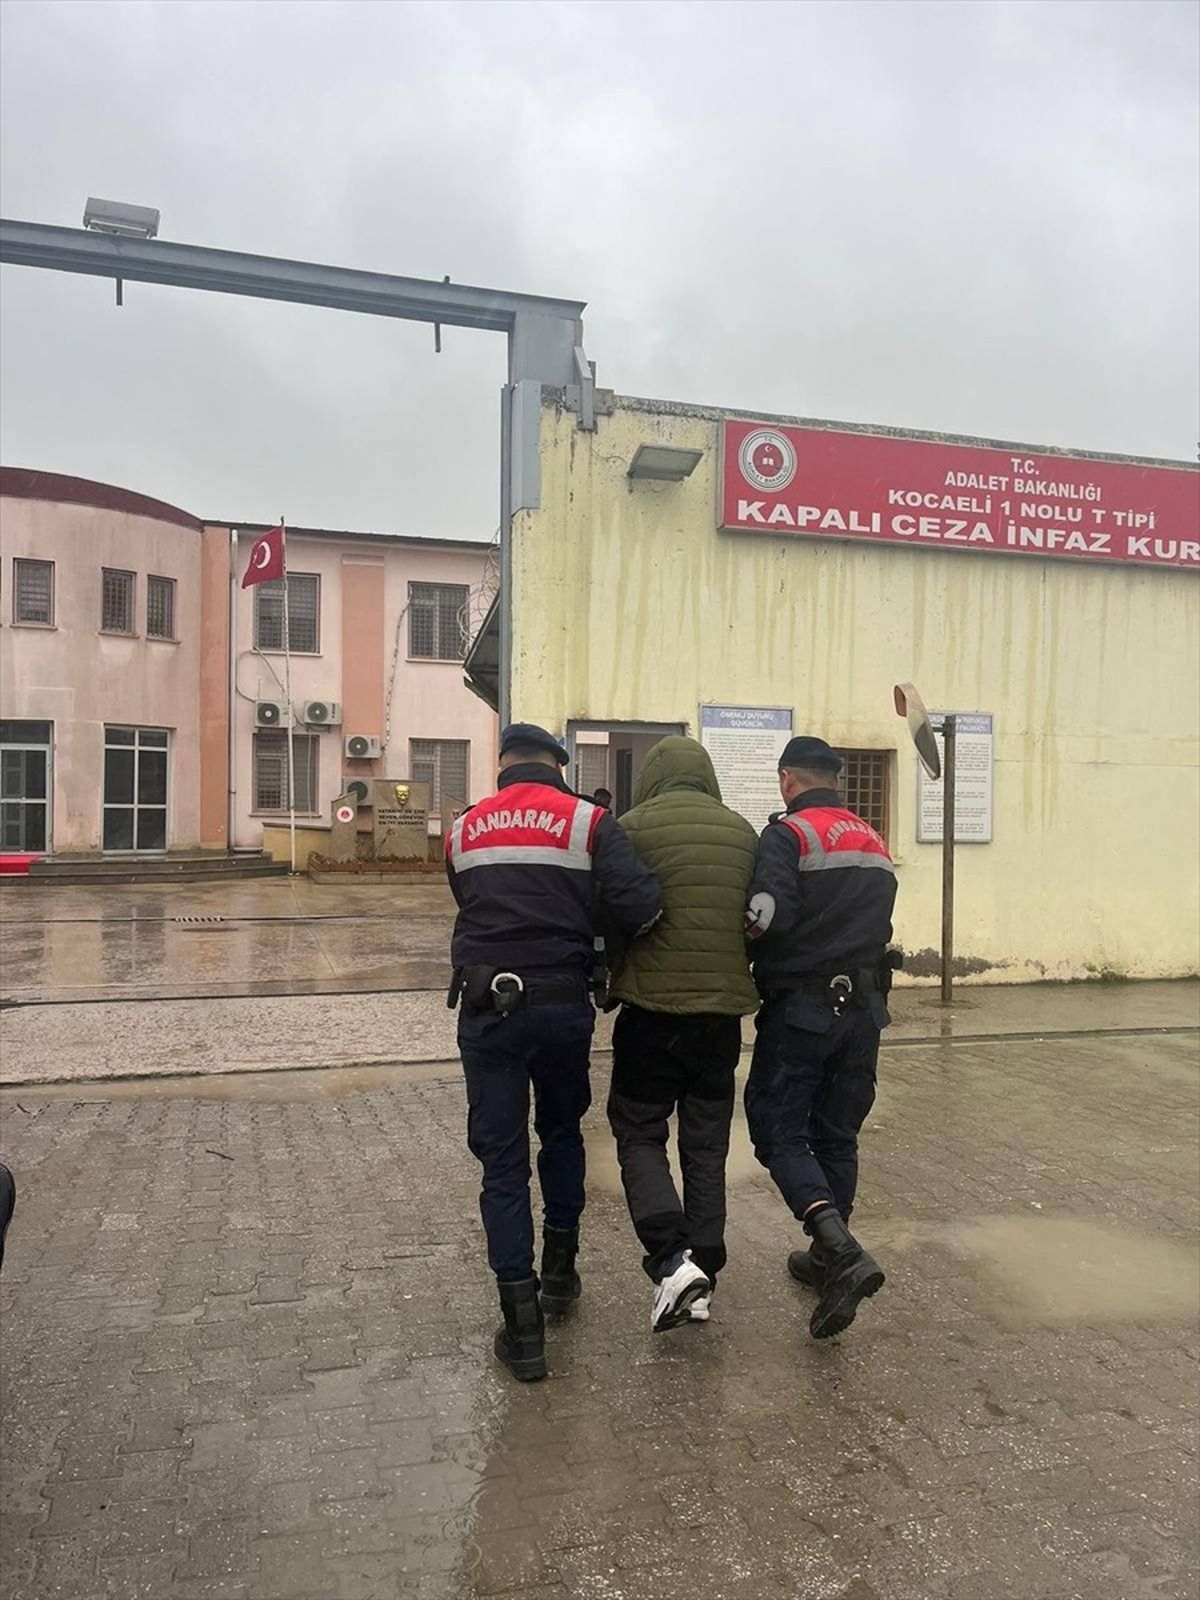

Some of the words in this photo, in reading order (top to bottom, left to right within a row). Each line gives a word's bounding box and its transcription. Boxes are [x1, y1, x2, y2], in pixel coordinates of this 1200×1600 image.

[1010, 458, 1040, 475] T.C.
[944, 471, 1009, 492] ADALET
[1014, 478, 1101, 502] BAKANLIĞI
[888, 489, 992, 514] KOCAELİ
[1000, 500, 1011, 516] 1
[1020, 502, 1083, 523] NOLU
[1091, 508, 1107, 525] T
[1113, 509, 1156, 530] TİPİ
[737, 499, 881, 533] KAPALI
[891, 514, 995, 543] CEZA
[1007, 520, 1112, 553] İNFAZ
[1127, 536, 1200, 561] KUR
[466, 808, 567, 842] JANDARMA
